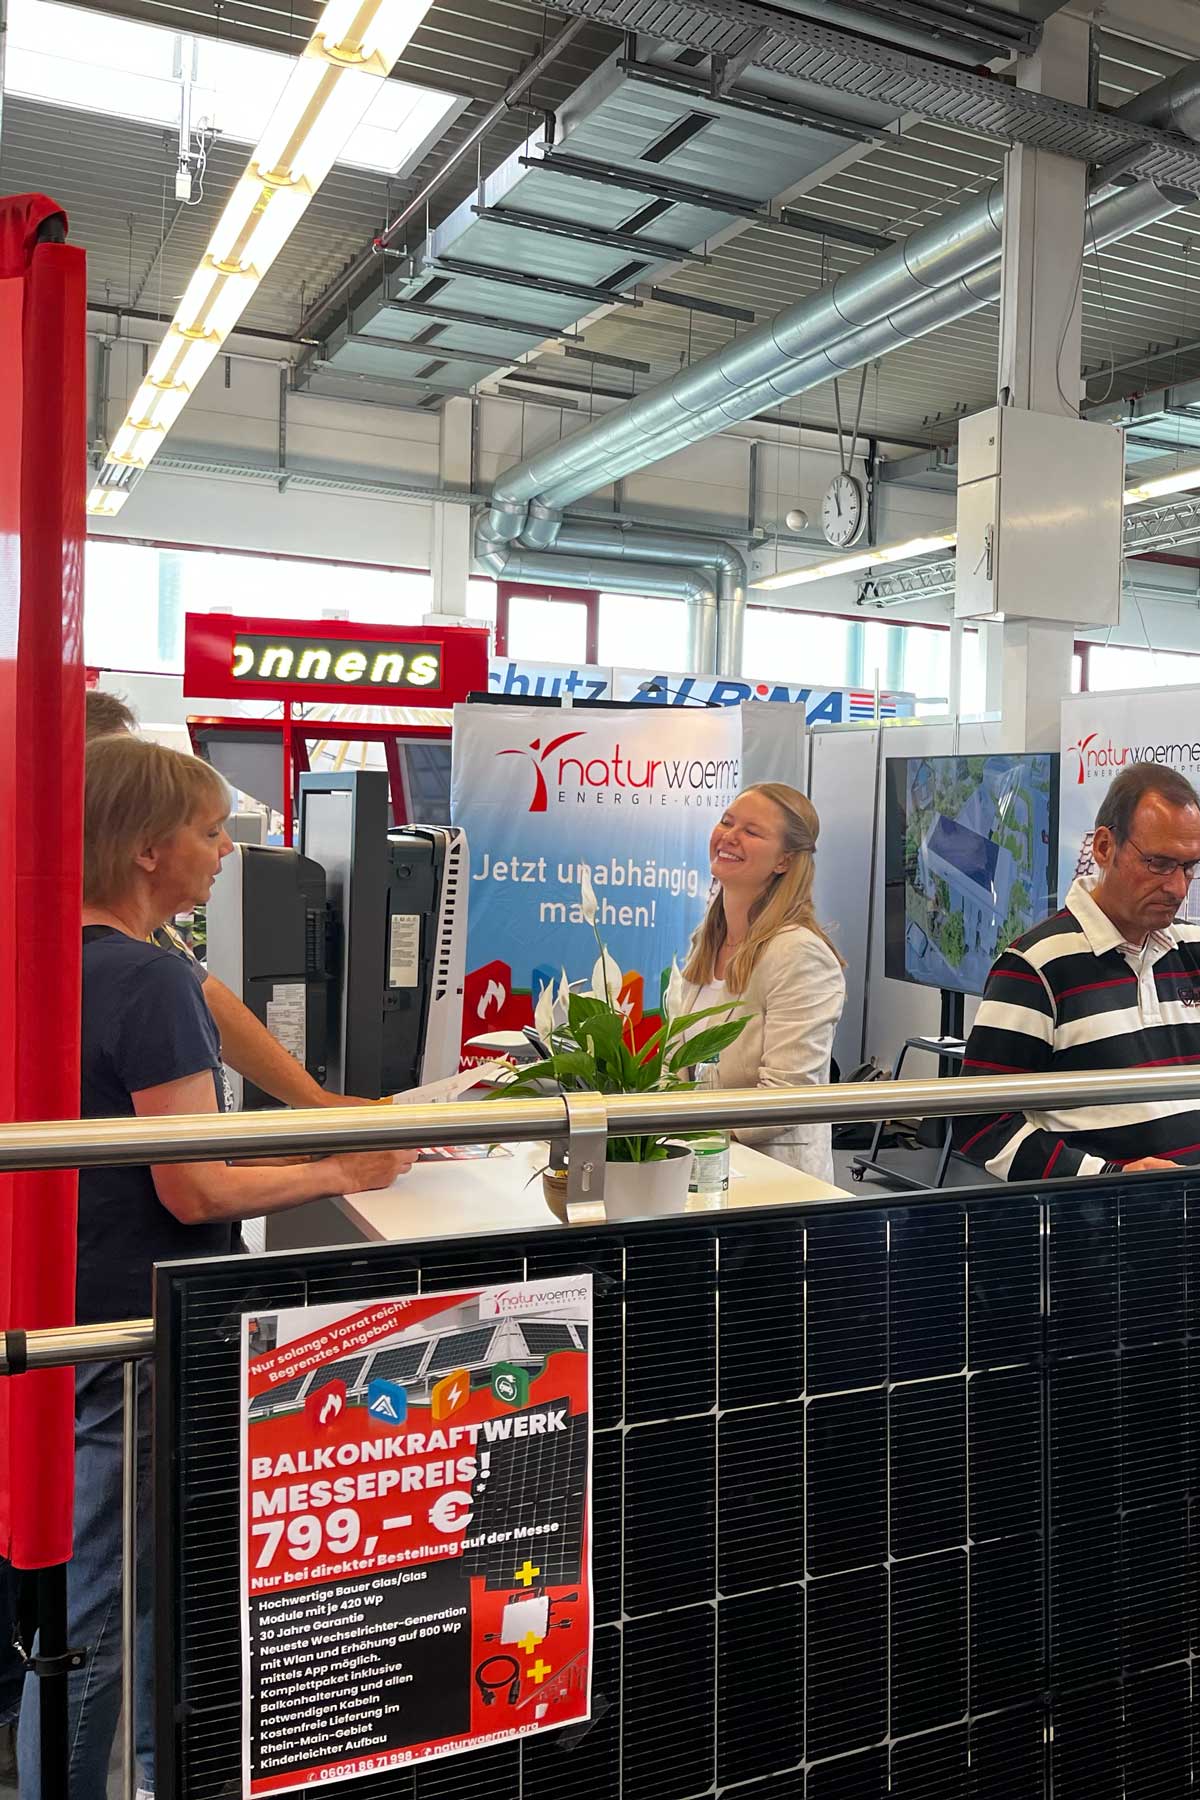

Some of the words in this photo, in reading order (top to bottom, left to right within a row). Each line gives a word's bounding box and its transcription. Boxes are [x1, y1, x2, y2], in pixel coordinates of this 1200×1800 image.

[472, 854, 547, 883] Jetzt
[558, 858, 699, 898] unabhängig
[539, 900, 656, 928] mahen!
[251, 1358, 275, 1376] Nur
[278, 1335, 328, 1365] solange
[329, 1317, 371, 1341] Vorrat
[371, 1300, 413, 1323] reicht!
[268, 1345, 341, 1382] Begrenztes
[342, 1317, 399, 1349] Angebot!
[252, 1409, 567, 1480] BALKONKRAFTWERK
[252, 1452, 491, 1518] MESSEPREIS!
[251, 1576, 281, 1590] Nur
[284, 1567, 309, 1583] bei
[311, 1558, 375, 1578] direkter
[377, 1541, 458, 1566] Bestellung
[460, 1534, 486, 1549] auf
[487, 1531, 513, 1544] der
[513, 1522, 560, 1539] Messe
[258, 1590, 334, 1611] Hochwertige
[335, 1583, 370, 1596] Bauer
[371, 1571, 428, 1589] Glas/Glas
[259, 1610, 304, 1627] Module
[305, 1604, 326, 1617] mit
[326, 1603, 339, 1616] je
[340, 1598, 362, 1610] 420
[363, 1594, 384, 1606] Wp
[259, 1629, 275, 1641] 30
[276, 1624, 311, 1638] Jahre
[312, 1612, 365, 1630] Garantie
[260, 1639, 309, 1656] Neueste
[311, 1607, 467, 1646] Wechselrichter-Generation
[260, 1659, 282, 1671] mit
[283, 1653, 314, 1667] Wlan
[316, 1646, 339, 1660] und
[341, 1636, 396, 1655] Erhöhung
[398, 1629, 418, 1642] auf
[419, 1625, 441, 1638] 800
[442, 1622, 462, 1634] Wp
[260, 1669, 303, 1685] mittels
[304, 1664, 328, 1678] App
[330, 1653, 381, 1671] möglich.
[260, 1673, 349, 1699] Komplettpaket
[350, 1662, 403, 1680] inklusive
[260, 1686, 359, 1713] Balkonhalterung
[360, 1678, 384, 1692] und
[384, 1674, 414, 1686] allen
[260, 1703, 338, 1727] notwendigen
[339, 1694, 380, 1710] Kabeln
[260, 1719, 328, 1741] Kostenfreie
[329, 1707, 383, 1726] Lieferung
[384, 1703, 400, 1714] im
[260, 1723, 373, 1755] Rhein-Main-Gebiet
[260, 1744, 344, 1769] Kinderleichter
[345, 1734, 388, 1751] Aufbau
[320, 1763, 357, 1780] 06021
[358, 1759, 374, 1771] 86
[377, 1756, 388, 1767] 71
[390, 1750, 413, 1765] 998
